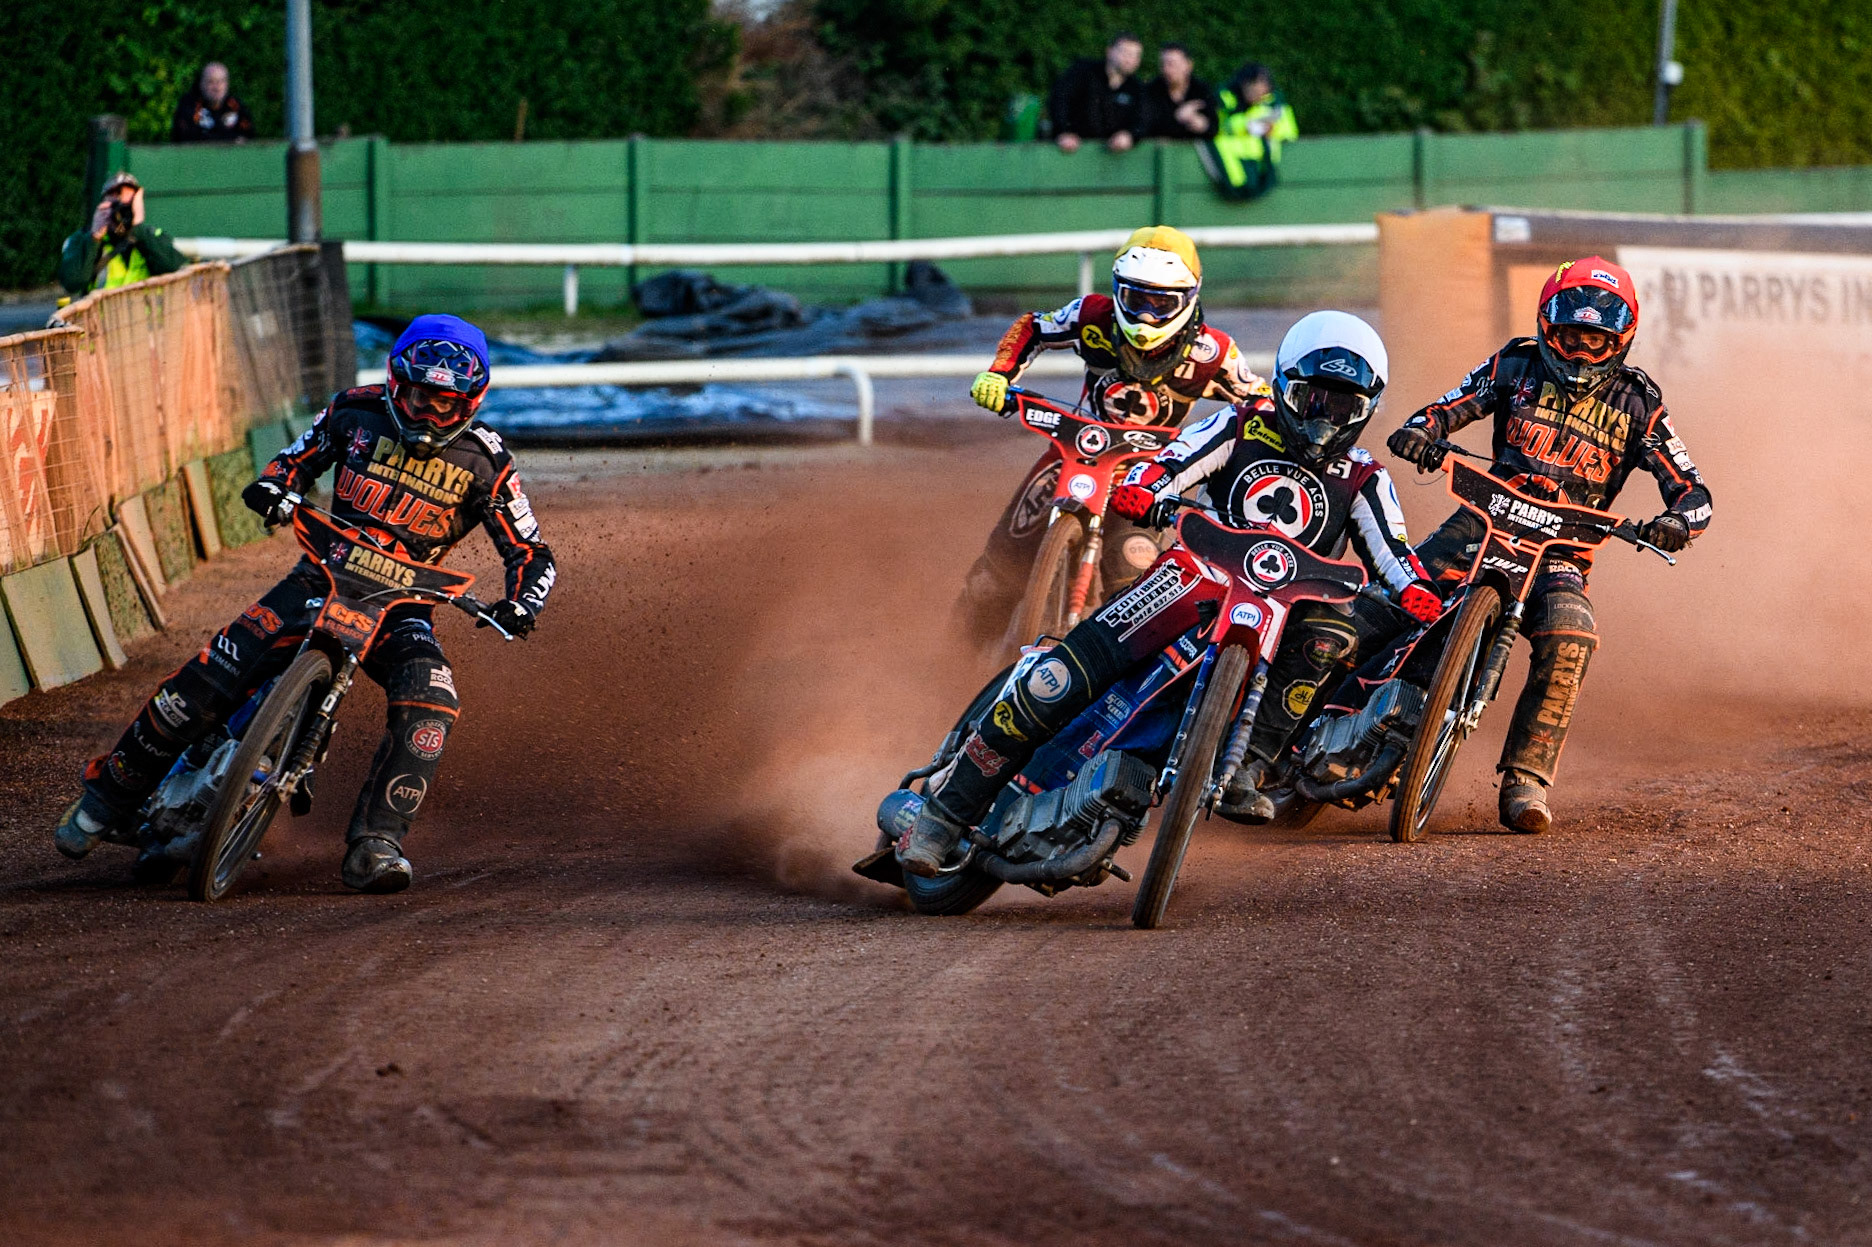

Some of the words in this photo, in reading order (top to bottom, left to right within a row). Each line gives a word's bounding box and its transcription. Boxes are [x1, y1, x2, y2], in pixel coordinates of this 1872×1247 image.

[1697, 271, 1830, 325] PARRYS
[1025, 408, 1062, 426] EDGE
[1242, 464, 1280, 485] BELLE
[1286, 466, 1310, 486] VUE
[1308, 486, 1324, 518] ACES
[1510, 499, 1564, 532] PARRYS
[1250, 543, 1269, 557] BELLE
[1482, 555, 1529, 574] JWP
[347, 545, 417, 588] PARRYS
[1121, 576, 1179, 621] FLOORING
[327, 601, 376, 634] CFS
[1235, 610, 1256, 622] ATPI
[1038, 666, 1061, 693] ATPI
[1536, 641, 1580, 727] PARRYS
[416, 730, 440, 748] STS
[393, 785, 422, 801] ATPI
